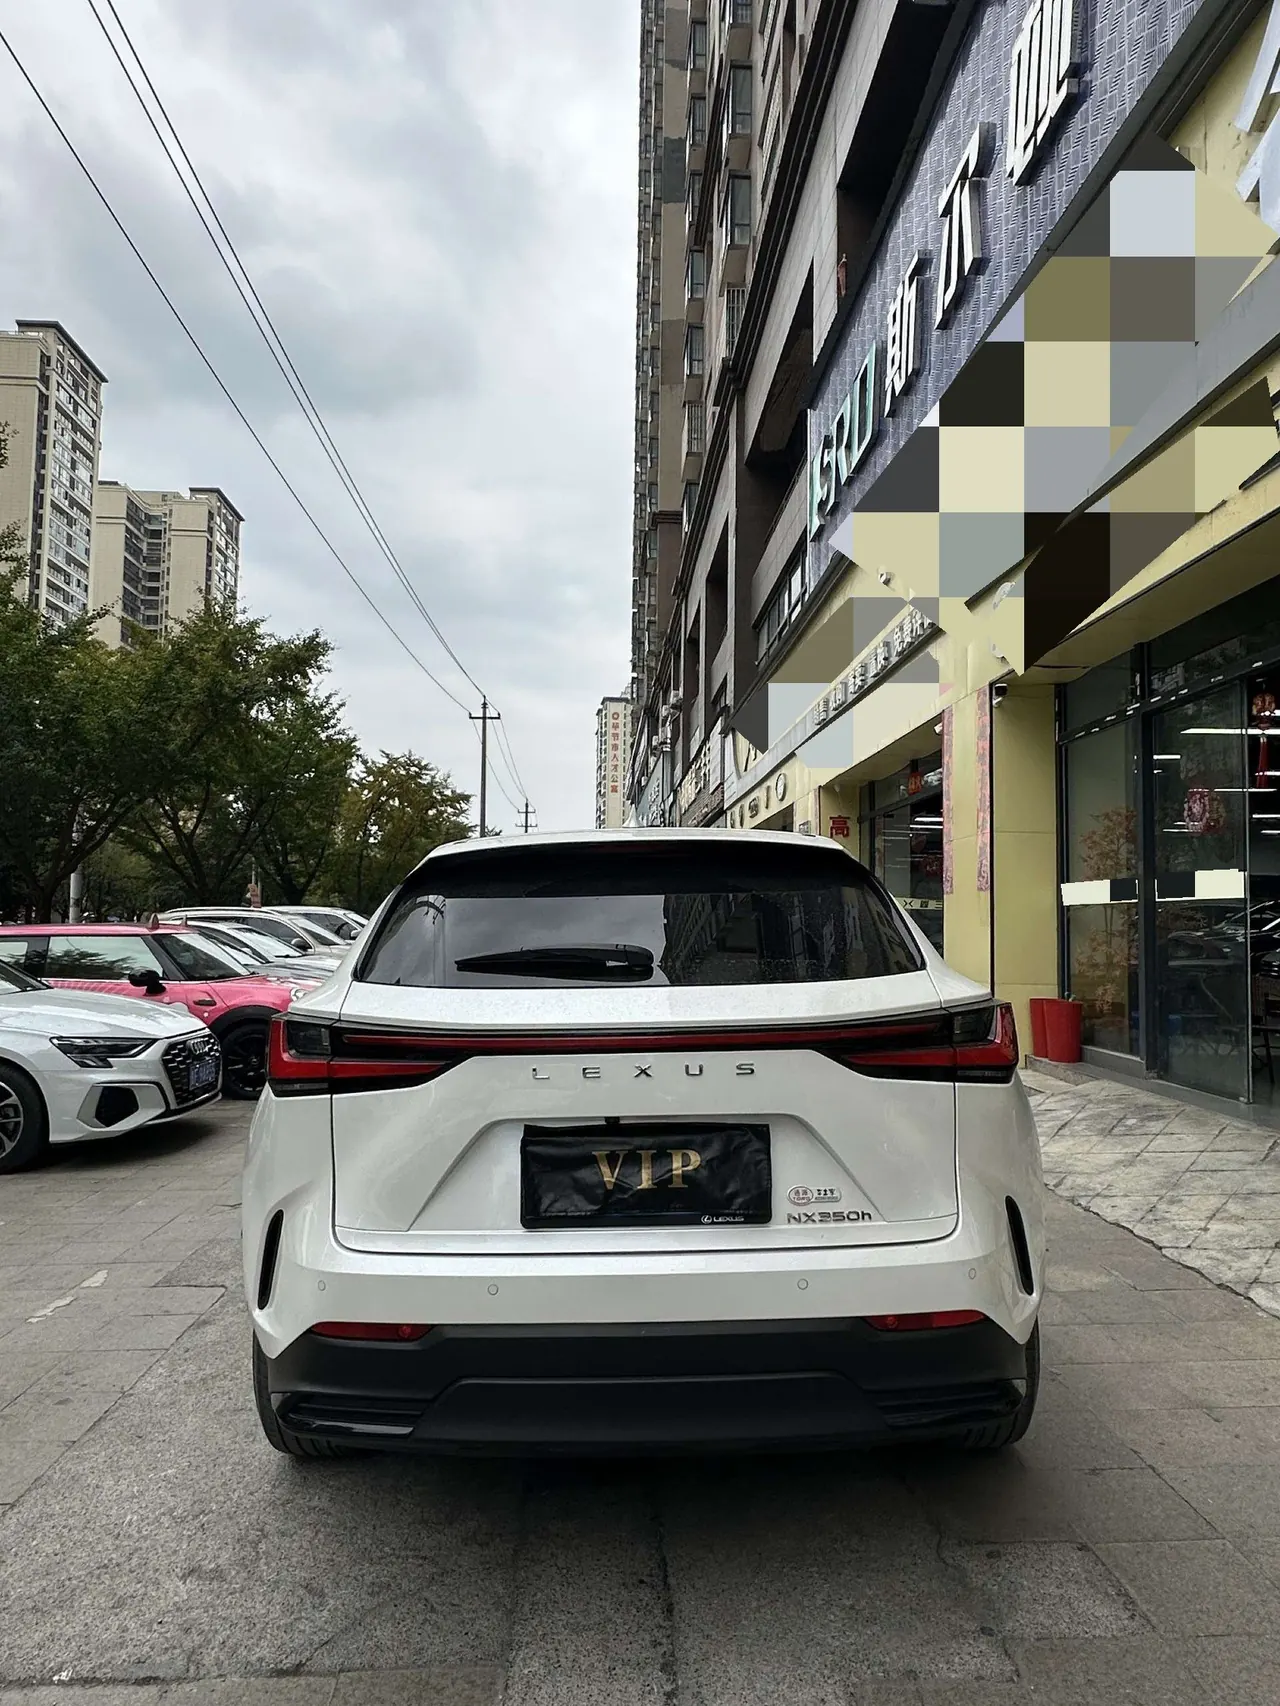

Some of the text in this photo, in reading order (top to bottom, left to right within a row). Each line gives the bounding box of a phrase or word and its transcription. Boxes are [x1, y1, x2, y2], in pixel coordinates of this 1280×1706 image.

[611, 721, 620, 793] 毕节市人才公寓
[829, 815, 850, 838] 高
[531, 1062, 756, 1080] LEXUS
[592, 1149, 701, 1190] VIP
[713, 1215, 745, 1223] LEXUS
[786, 1210, 872, 1224] NX350h
